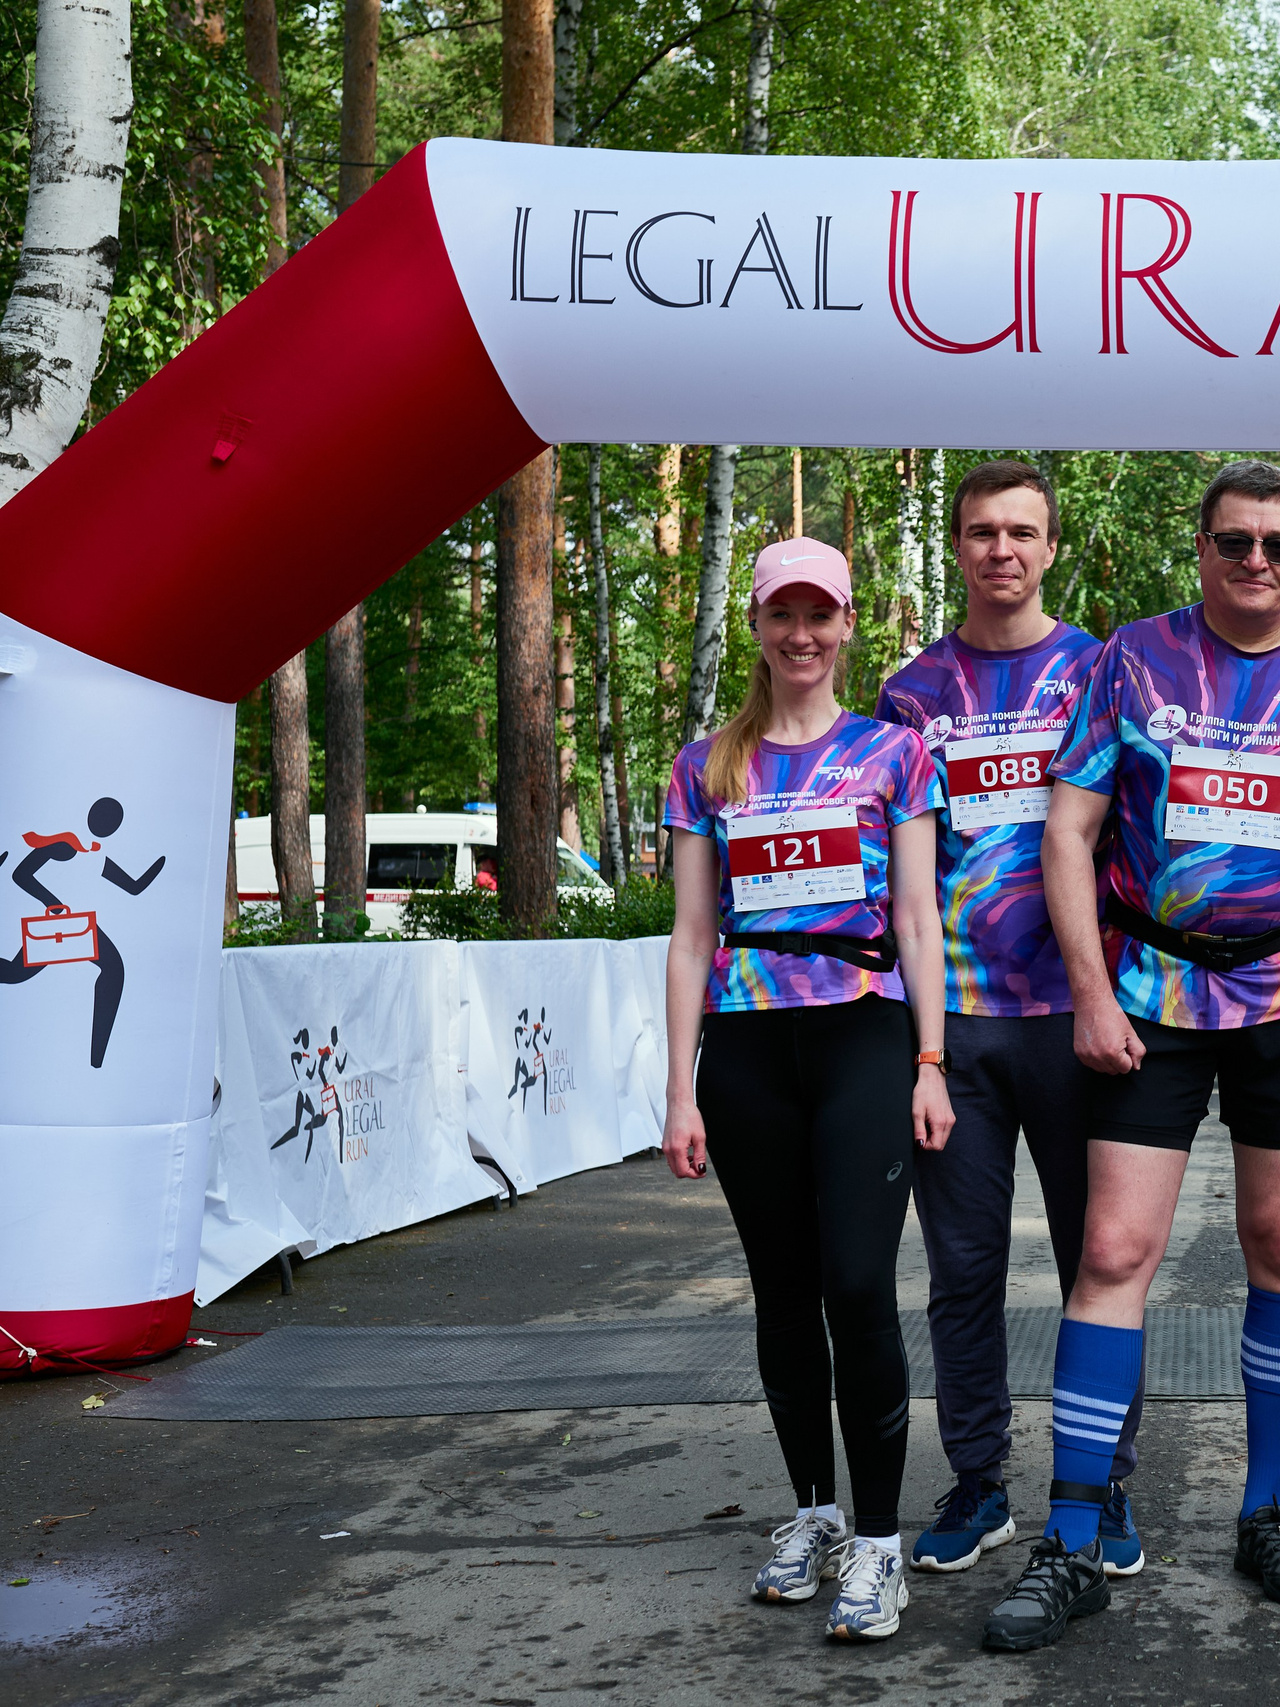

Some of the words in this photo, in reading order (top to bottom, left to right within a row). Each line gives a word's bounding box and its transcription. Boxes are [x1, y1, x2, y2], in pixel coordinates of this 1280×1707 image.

[510, 206, 864, 311] LEGAL
[955, 712, 989, 727] Группа
[992, 707, 1040, 721] компаний
[1190, 711, 1225, 728] Группа
[1228, 719, 1278, 732] компаний
[956, 722, 997, 737] НАЛОГИ
[998, 722, 1006, 733] И
[1188, 725, 1230, 743] НАЛОГИ
[1232, 734, 1240, 745] И
[979, 756, 1042, 788] 088
[748, 792, 776, 803] Группа
[777, 790, 816, 800] компаний
[1203, 774, 1268, 807] 050
[748, 800, 780, 811] НАЛОГИ
[782, 800, 788, 808] И
[789, 797, 845, 807] ФИНАНСОВОЕ
[762, 834, 822, 867] 121
[549, 1048, 568, 1068] URAL
[344, 1077, 376, 1102] URAL
[549, 1066, 577, 1095] LEGAL
[550, 1096, 567, 1115] RUN
[345, 1100, 386, 1137] LEGAL
[346, 1136, 369, 1162] RUN
